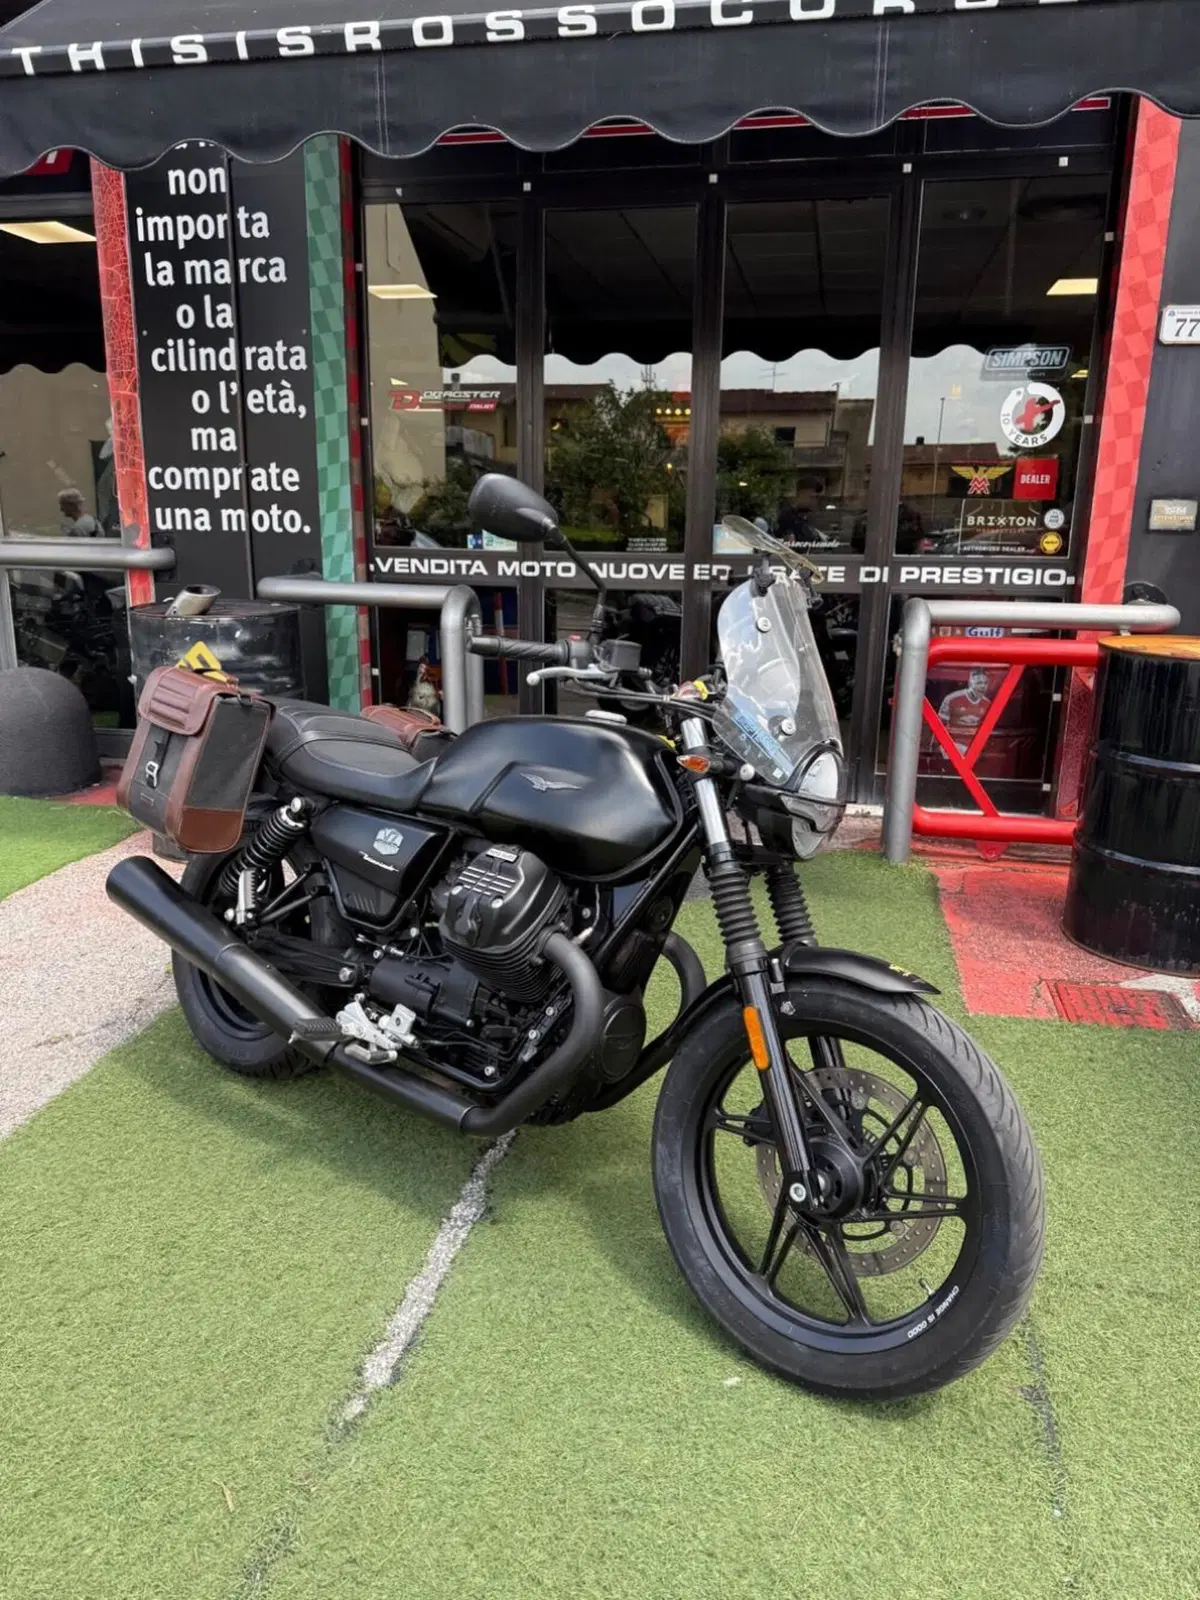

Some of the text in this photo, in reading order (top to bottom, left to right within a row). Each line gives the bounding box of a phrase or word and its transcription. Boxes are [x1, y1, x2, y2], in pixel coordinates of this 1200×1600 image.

[168, 166, 226, 196] non
[136, 206, 270, 250] importa
[144, 252, 287, 287] la marca
[176, 294, 235, 329] o la
[151, 337, 308, 372] cilindrata
[991, 350, 1064, 367] SIMPSON
[191, 389, 211, 414] o
[422, 390, 501, 399] DRAGSTER
[190, 426, 238, 452] ma
[1008, 427, 1048, 446] YEARS
[148, 461, 300, 499] comprate
[1019, 473, 1051, 485] DEALER
[155, 503, 312, 534] una moto.
[966, 515, 1037, 527] BRIXTON
[375, 557, 488, 575] VENDITA
[498, 560, 577, 578] MOTO
[588, 562, 686, 581] NUOVE
[859, 566, 890, 583] DI
[967, 626, 1003, 637] Gulf
[927, 1313, 936, 1324] IS
